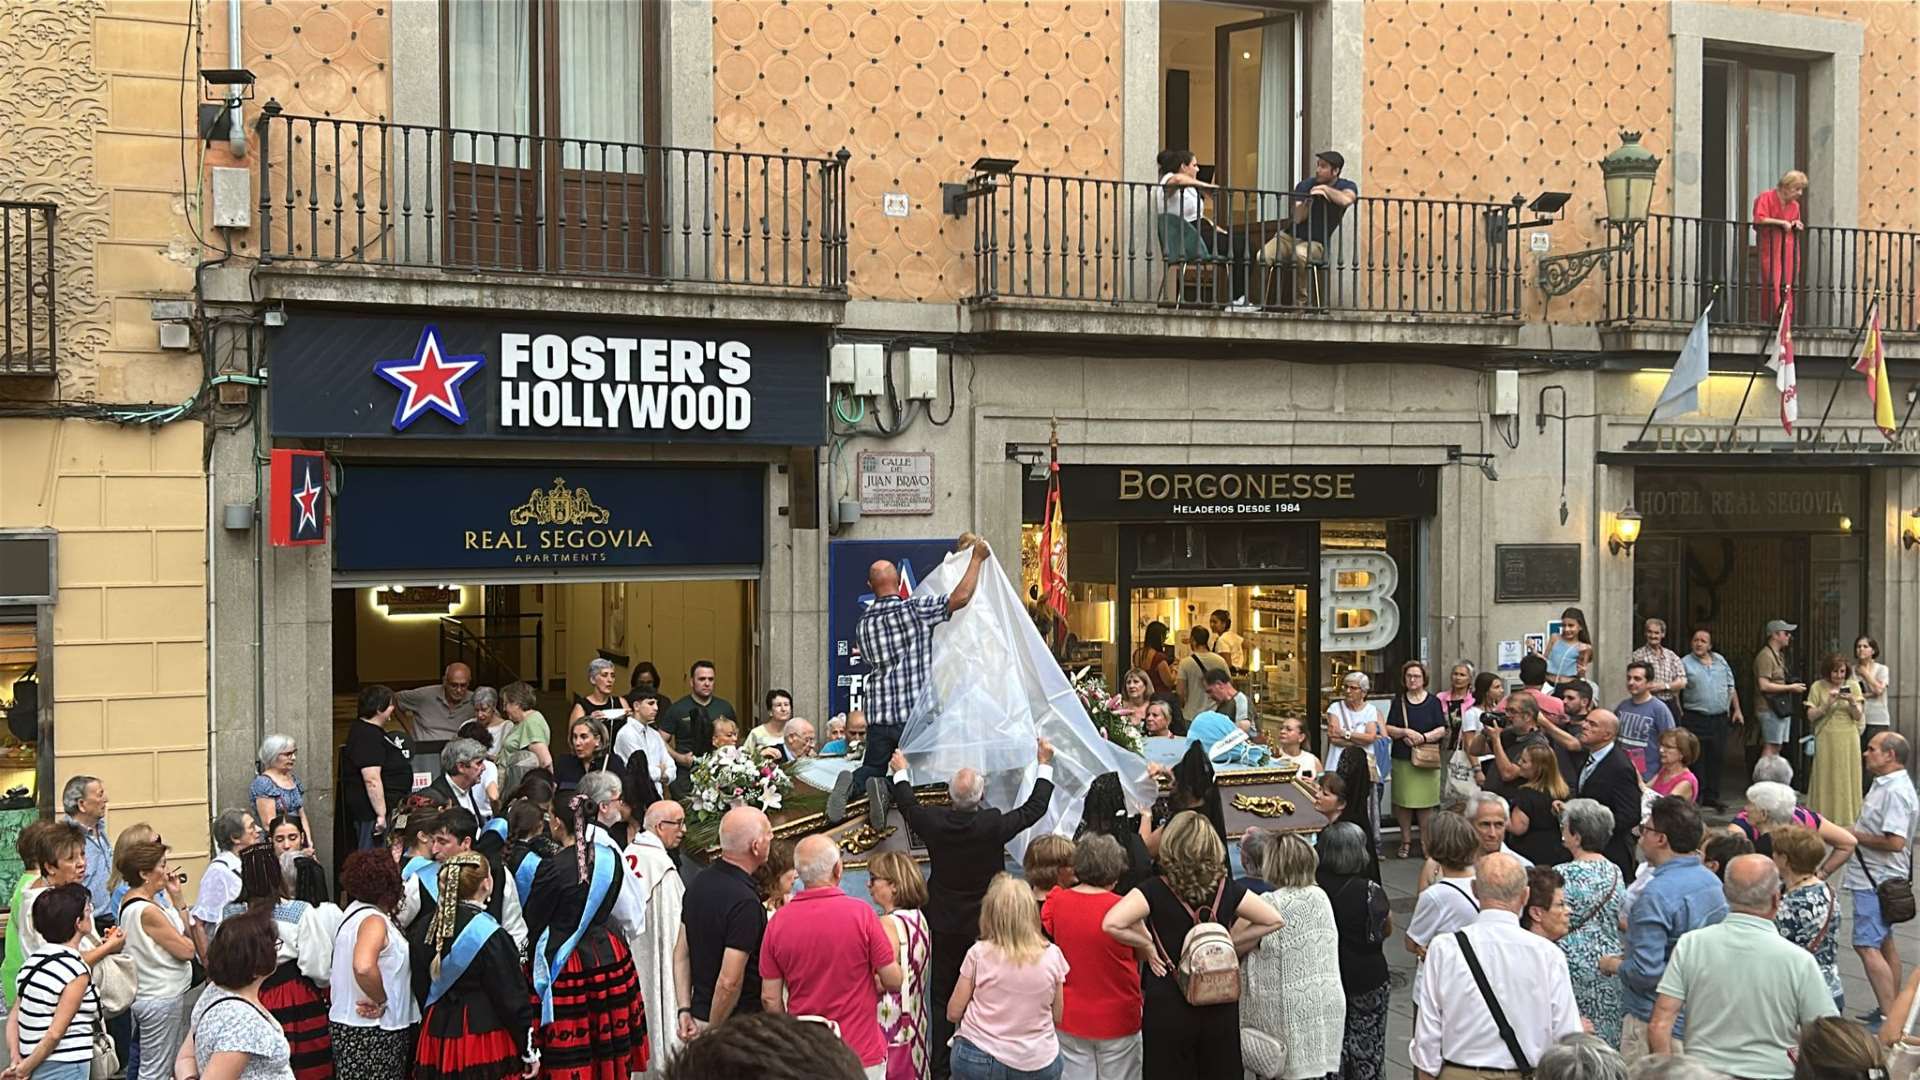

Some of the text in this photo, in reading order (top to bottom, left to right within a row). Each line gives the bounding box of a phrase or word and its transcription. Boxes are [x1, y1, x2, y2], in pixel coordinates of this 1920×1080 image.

[501, 333, 751, 385] FOSTER'S
[501, 381, 751, 430] HOLLYWOOD
[1655, 427, 1773, 452] HOTEL
[881, 458, 911, 466] CALLE
[864, 475, 929, 488] JUAN BRAVO
[1119, 469, 1355, 500] BORGONESSE
[1173, 503, 1301, 514] HELADEROS DESDE 1984
[1640, 491, 1704, 515] HOTEL
[1767, 489, 1844, 514] SEGOVIA
[464, 530, 653, 549] REAL SEGOVIA
[514, 553, 607, 563] APARTMENTS
[1320, 549, 1400, 653] B
